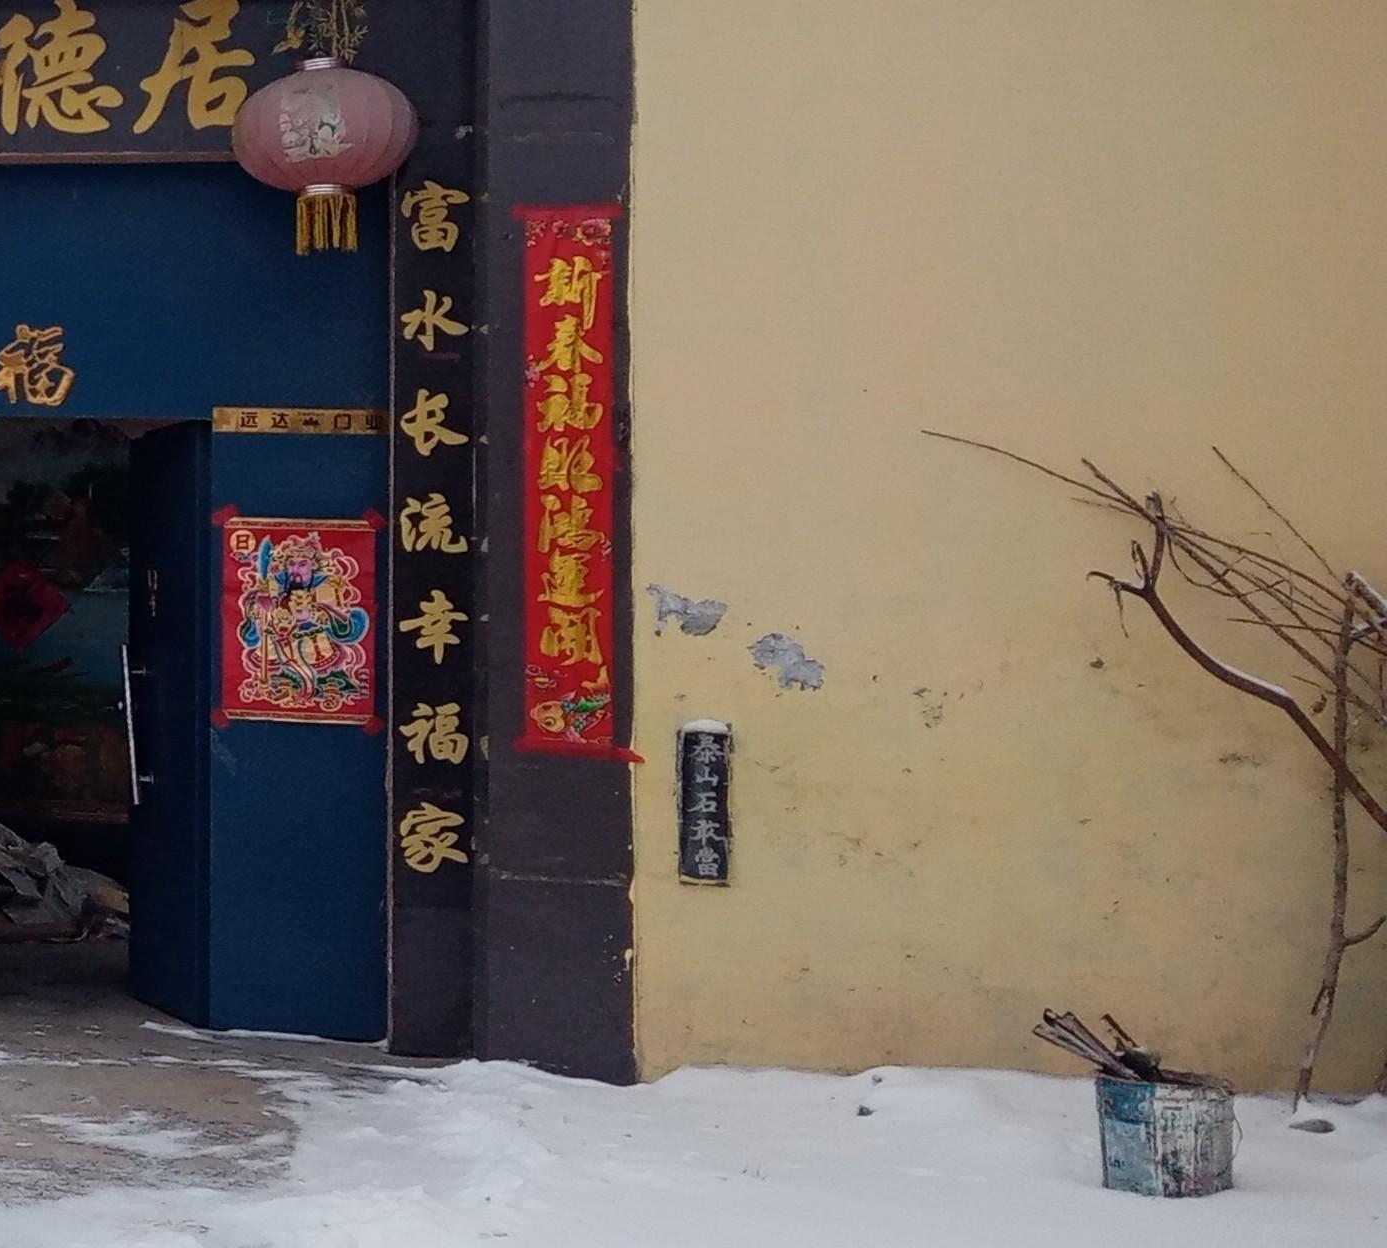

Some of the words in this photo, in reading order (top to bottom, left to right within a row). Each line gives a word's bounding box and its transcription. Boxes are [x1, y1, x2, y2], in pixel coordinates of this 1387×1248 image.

[235, 533, 251, 550] 日
[398, 180, 471, 874] 富水长流幸福家
